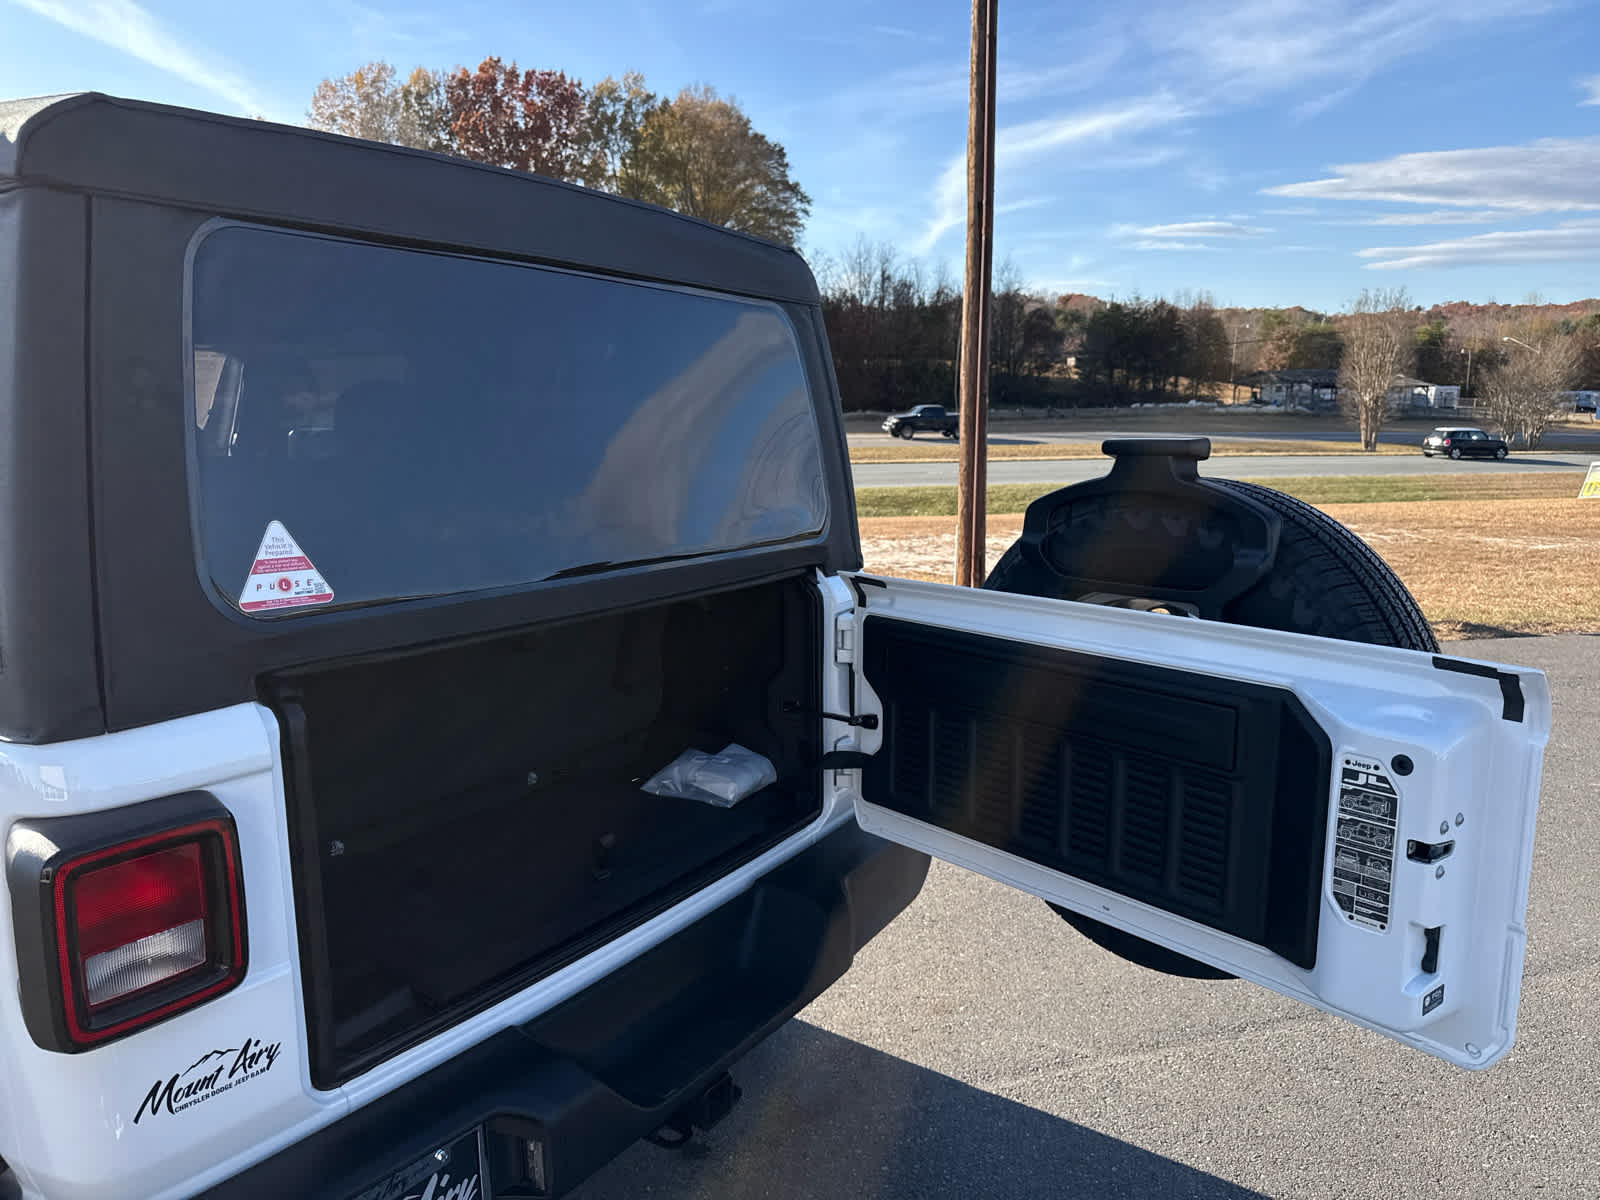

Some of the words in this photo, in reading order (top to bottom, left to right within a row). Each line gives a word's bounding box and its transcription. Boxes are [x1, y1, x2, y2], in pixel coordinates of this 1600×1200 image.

[256, 578, 314, 592] PULSE
[1352, 760, 1371, 770] Jeep
[1359, 887, 1384, 902] USA
[133, 1064, 224, 1124] Mount
[228, 1037, 281, 1079] Airy
[174, 1092, 210, 1113] CHRYSLER
[211, 1081, 233, 1097] DODGE
[233, 1074, 250, 1087] JEEP
[250, 1066, 267, 1078] RAM
